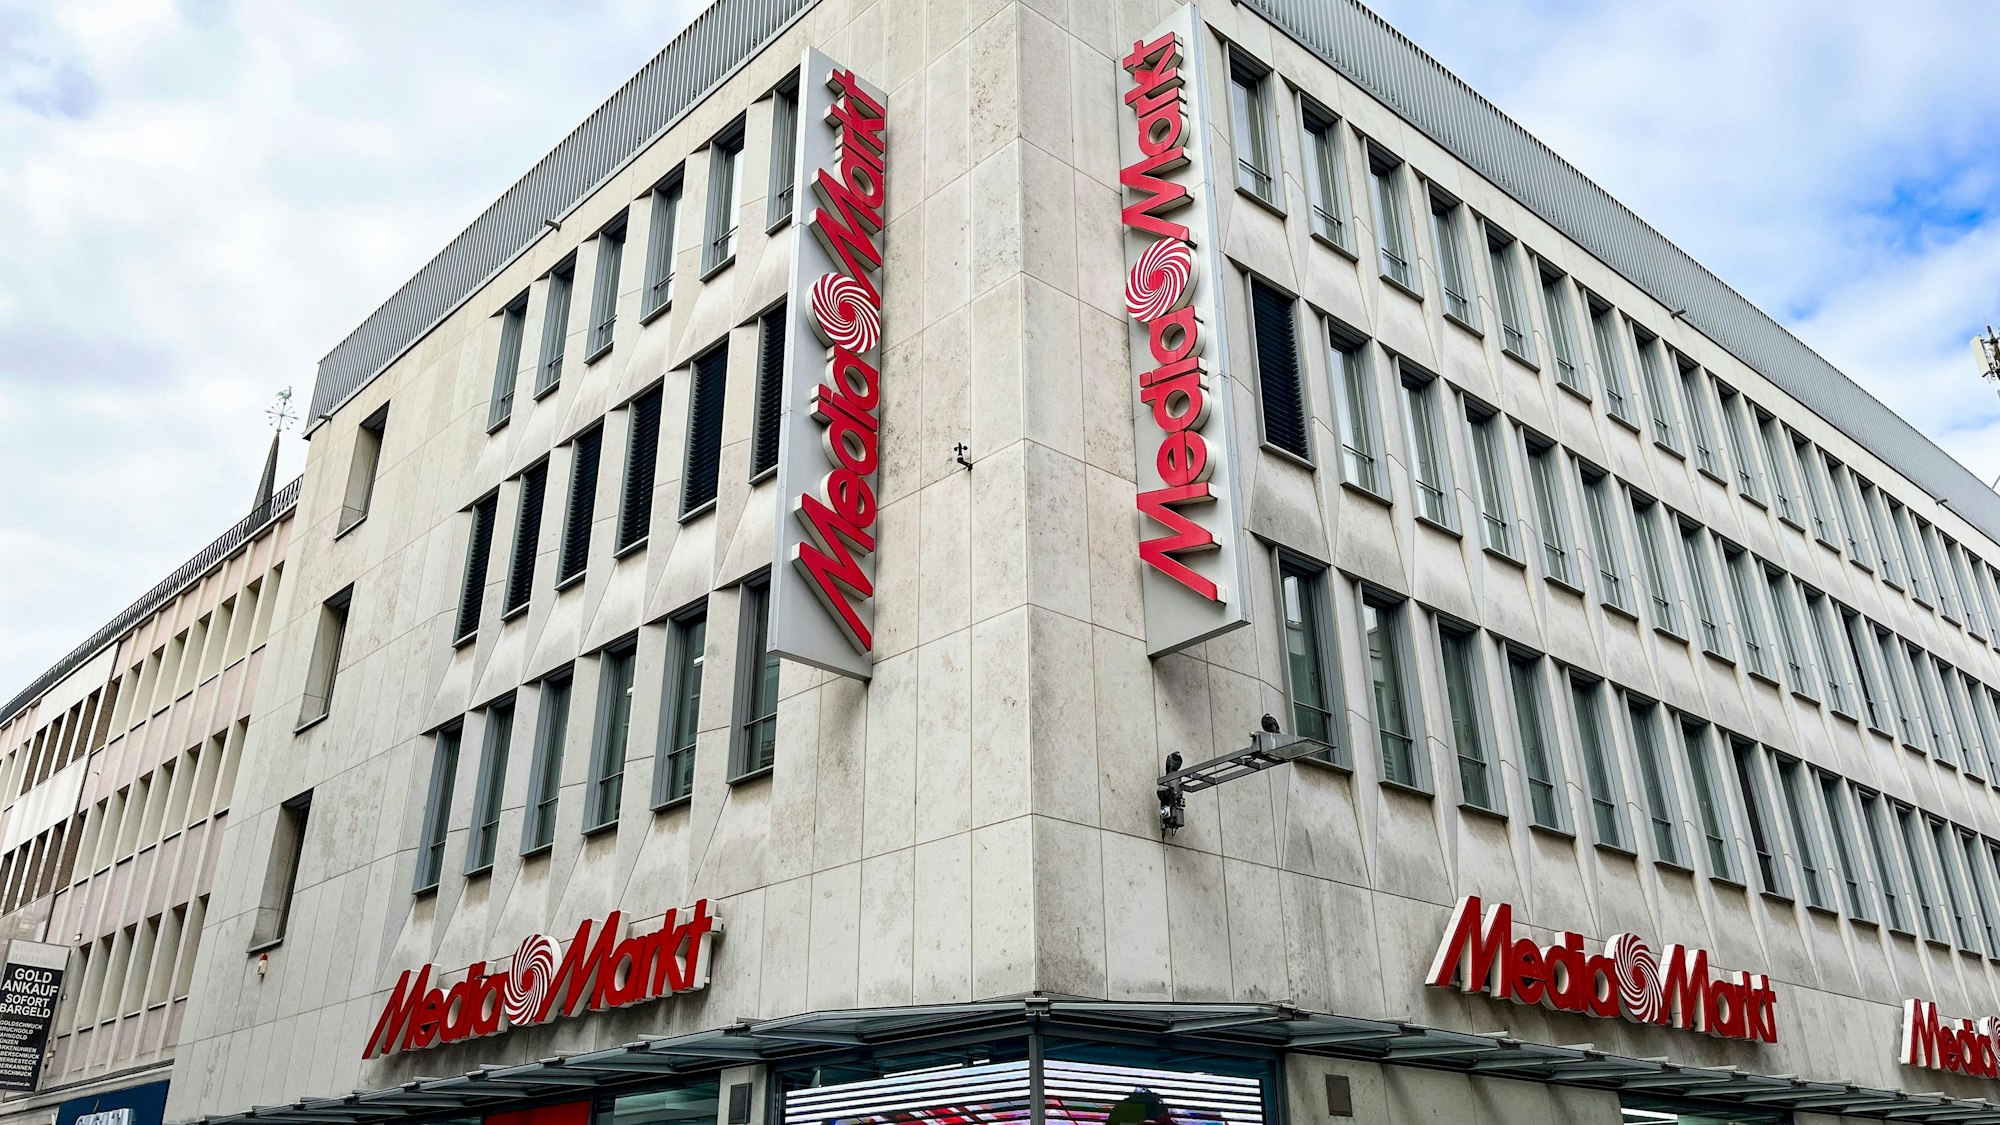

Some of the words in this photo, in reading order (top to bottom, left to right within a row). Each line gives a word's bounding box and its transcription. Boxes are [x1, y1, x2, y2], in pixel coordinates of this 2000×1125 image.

[814, 68, 886, 311] Markt
[1119, 31, 1193, 243] Markt
[797, 343, 880, 652] Media
[1136, 295, 1221, 604] Media
[0, 1002, 51, 1018] BARGELD
[1, 979, 59, 997] ANKAUF
[5, 993, 50, 1008] SOFORT
[14, 967, 53, 984] GOLD
[361, 960, 511, 1060] Media
[534, 898, 714, 1018] Markt
[1430, 895, 1627, 1018] Media
[1656, 943, 1778, 1044] Markt
[1904, 998, 1999, 1079] Media
